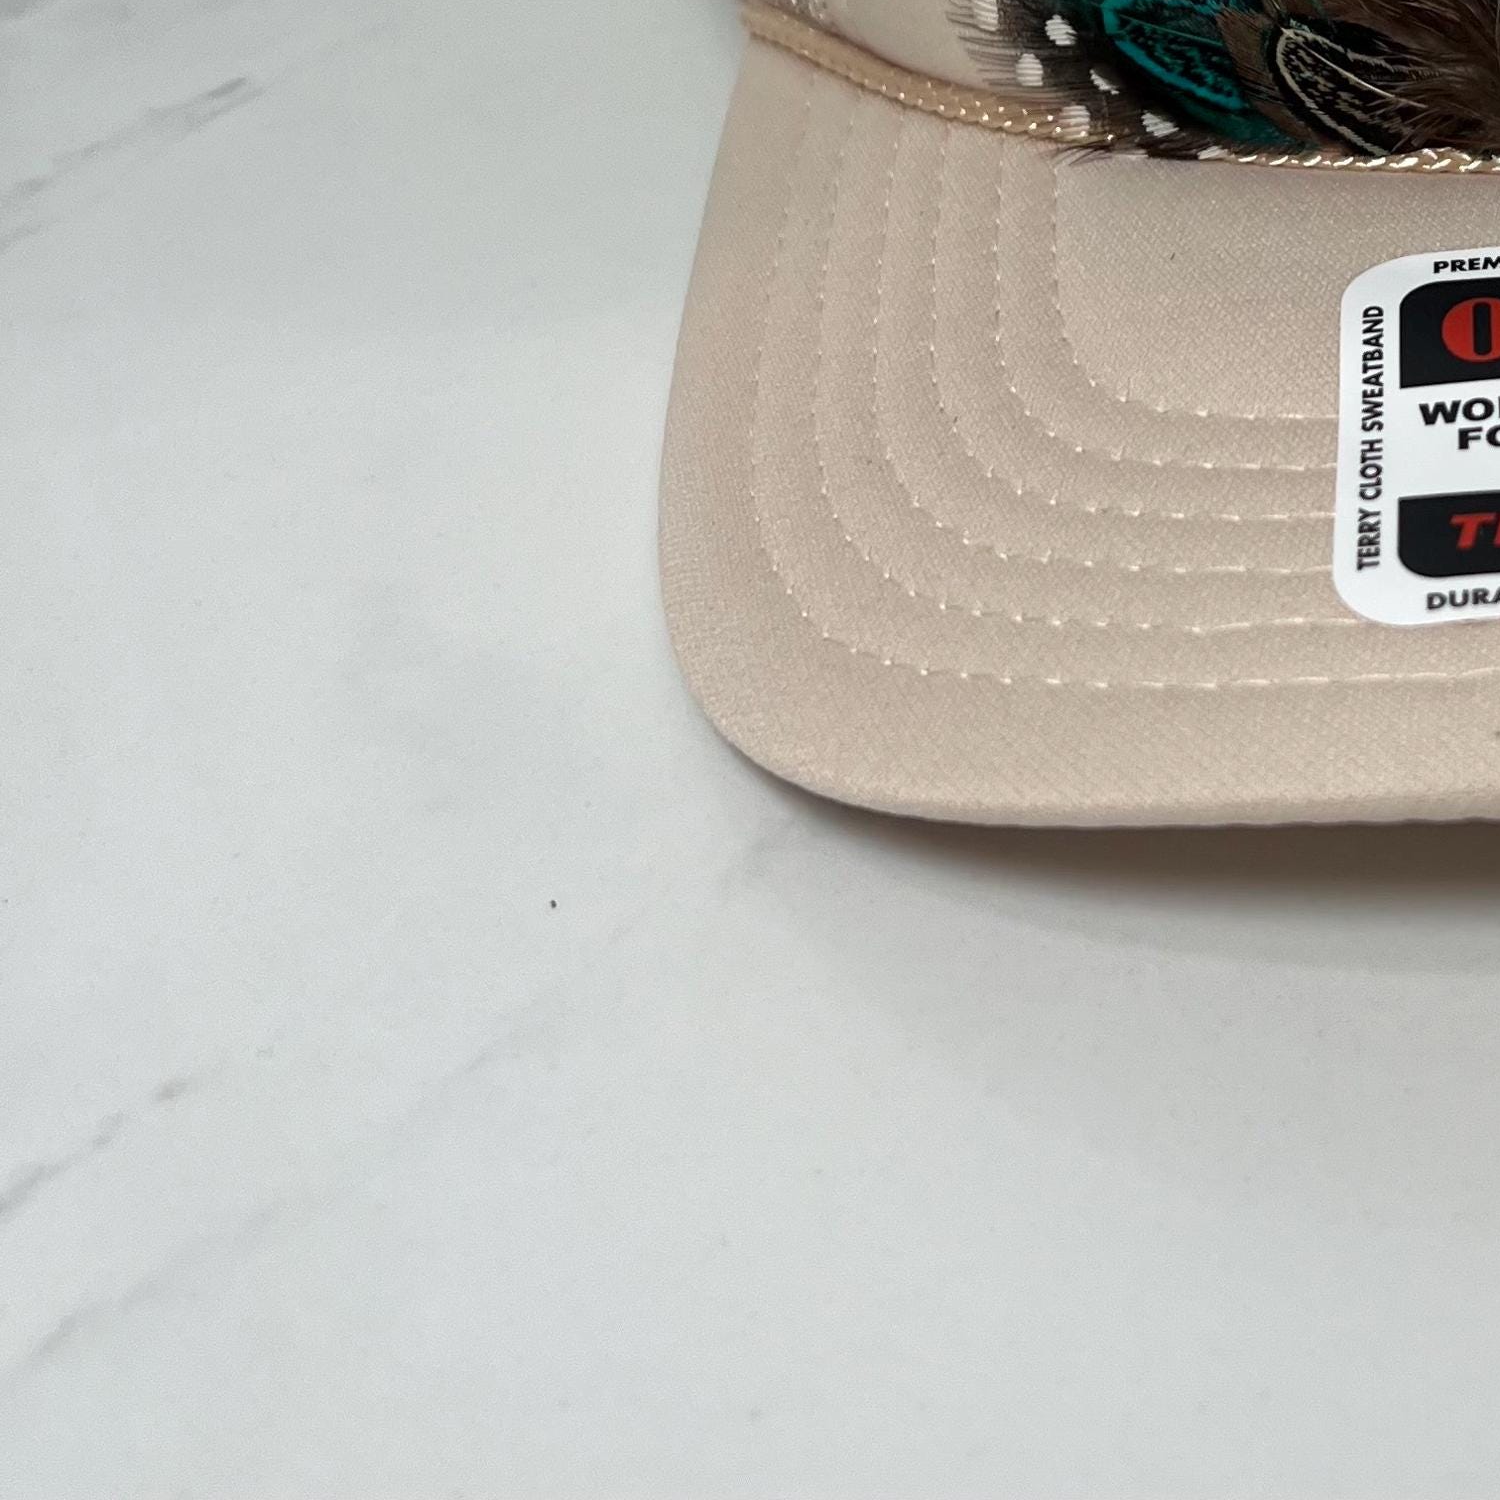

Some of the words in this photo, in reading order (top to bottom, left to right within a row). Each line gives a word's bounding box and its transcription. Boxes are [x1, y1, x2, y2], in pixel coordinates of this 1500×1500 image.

[1361, 305, 1384, 432] SWEATBAND
[1358, 438, 1383, 501] CLOTH
[1356, 508, 1381, 571] TERRY
